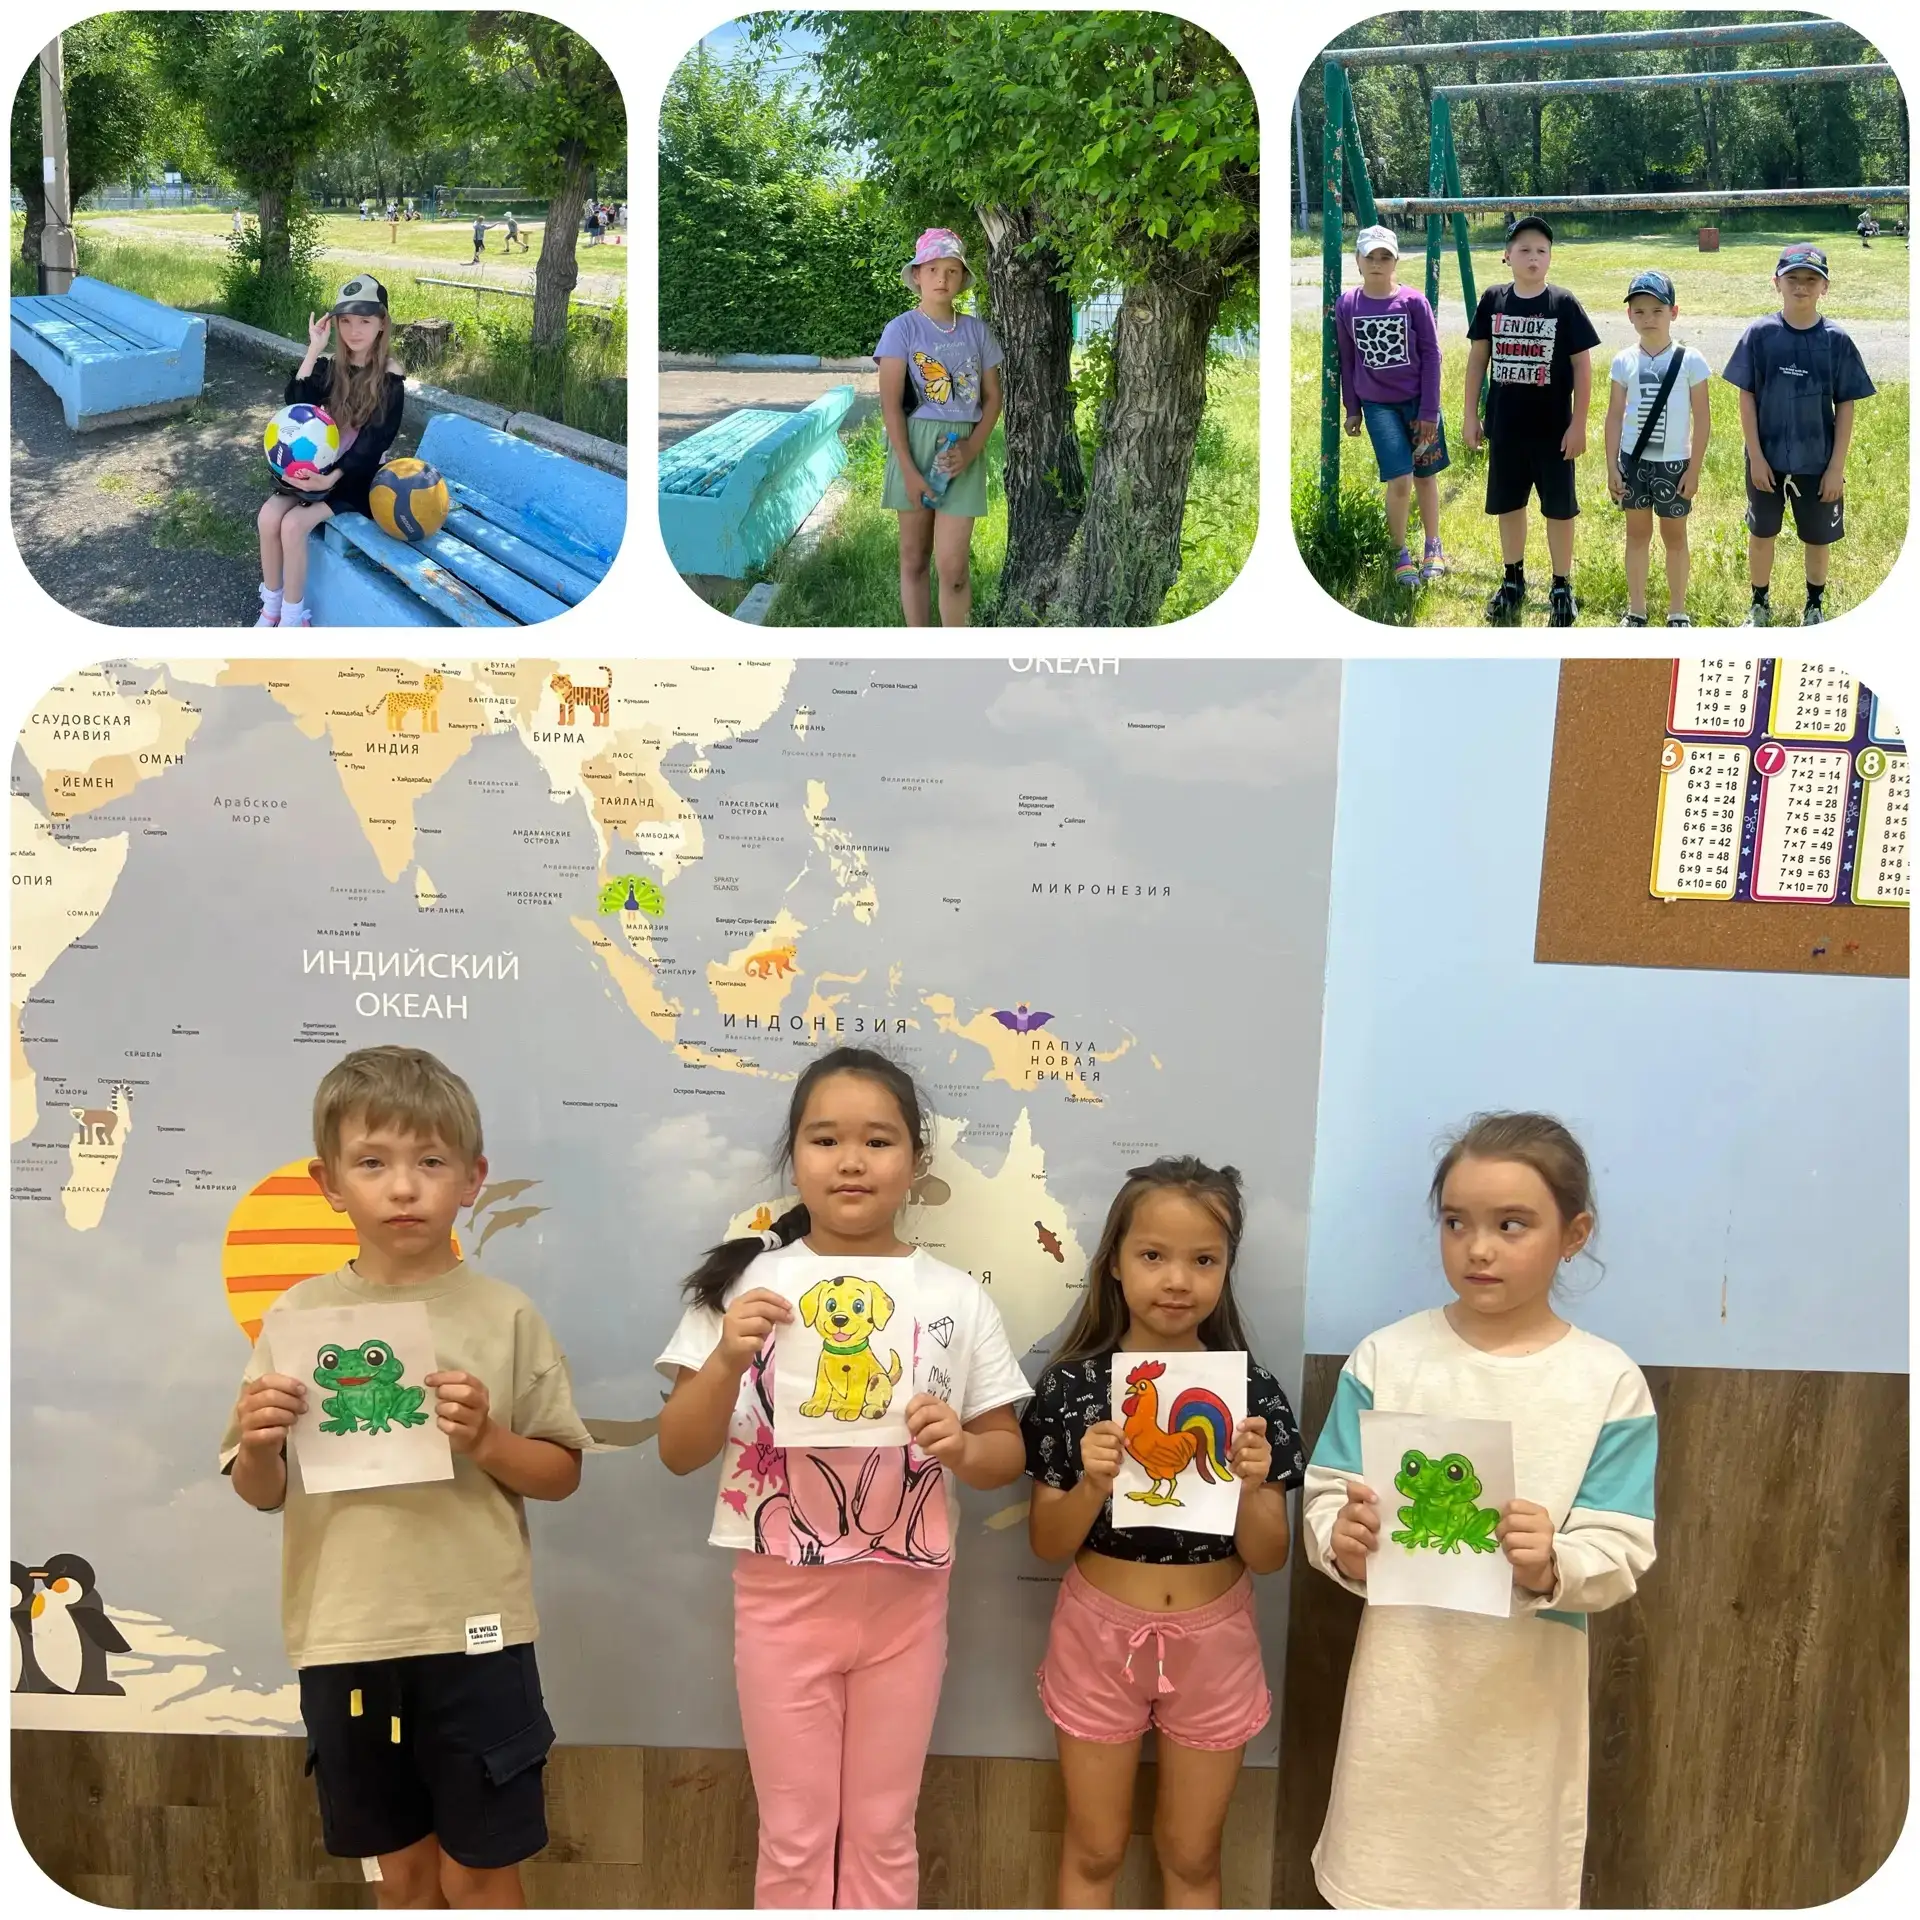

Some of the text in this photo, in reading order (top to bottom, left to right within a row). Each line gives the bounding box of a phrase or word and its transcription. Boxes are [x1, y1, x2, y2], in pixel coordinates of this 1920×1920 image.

[1502, 319, 1545, 334] ENJOY
[1495, 342, 1547, 358] SILENCE
[1746, 661, 1751, 669] 6
[1744, 675, 1750, 684] 7
[1839, 680, 1850, 689] 14
[1742, 690, 1748, 698] 8
[1837, 694, 1848, 703] 16
[468, 697, 517, 705] БАНГЛАДЕШ
[1740, 704, 1746, 713] 9
[1836, 709, 1847, 717] 18
[32, 714, 131, 726] САУДОВСКАЯ
[790, 724, 825, 732] ТАЙВАНЬ
[53, 731, 111, 741] АРАВИЯ
[533, 732, 585, 743] БИРМА
[366, 743, 419, 755] ИНДИЯ
[139, 754, 184, 765] ОМАН
[1662, 744, 1677, 766] 6
[1734, 753, 1740, 762] 6
[1764, 747, 1779, 770] 7
[1836, 757, 1841, 765] 7
[1863, 752, 1880, 775] 8
[688, 767, 726, 775] ХАЙНАНЬ
[62, 776, 114, 788] ЙЕМЕН
[214, 797, 288, 810] Арабское
[600, 797, 655, 808] ТАЙЛАНД
[719, 800, 779, 809] ПАРАСЕЛЬСКИЕ
[731, 808, 767, 816] ОСТРОВА
[232, 814, 271, 824] море
[678, 813, 714, 821] ВЬЕТНАМ
[512, 829, 571, 838] АНДАМАНСКИЕ
[635, 832, 680, 840] КАМБОДЖА
[524, 837, 559, 845] ОСТРОВА
[12, 875, 52, 886] ОПИЯ
[1032, 883, 1170, 896] МИКРОНЕЗИЯ
[507, 891, 563, 899] НИКОБАРСКИЕ
[518, 898, 552, 906] ОСТРОВА
[418, 907, 465, 915] ШРИ-ЛАНКА
[317, 928, 361, 937] МАЛЬДИВЫ
[303, 948, 519, 981] ИНДИЙСКИЙ
[355, 992, 467, 1019] ОКЕАН
[724, 1014, 906, 1033] ИНДОНЕЗИЯ
[1031, 1040, 1096, 1052] ПАПУА
[124, 1050, 162, 1058] СЕЙШЕЛЫ
[1031, 1055, 1096, 1067] НОВАЯ
[1025, 1070, 1100, 1082] ГВИНЕЯ
[60, 1186, 110, 1194] МАДАГАСКАР
[479, 1625, 498, 1633] WILD
